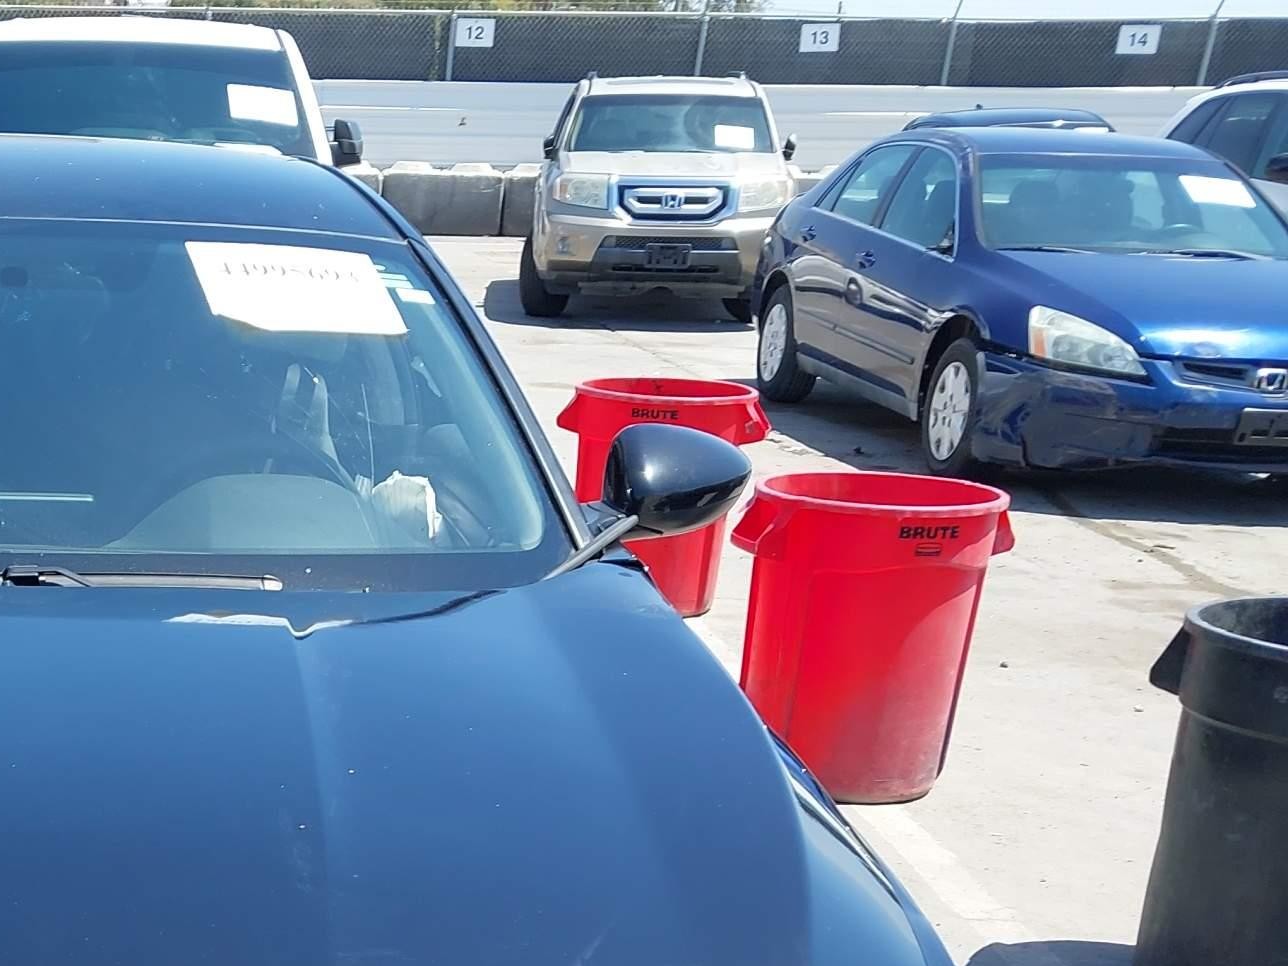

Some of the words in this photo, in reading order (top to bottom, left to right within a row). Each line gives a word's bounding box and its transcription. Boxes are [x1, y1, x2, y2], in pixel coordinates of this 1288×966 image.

[466, 26, 485, 40] 12
[811, 30, 830, 45] 13
[1129, 32, 1148, 47] 14
[631, 407, 680, 419] BRUTE
[899, 525, 960, 539] BRUTE
